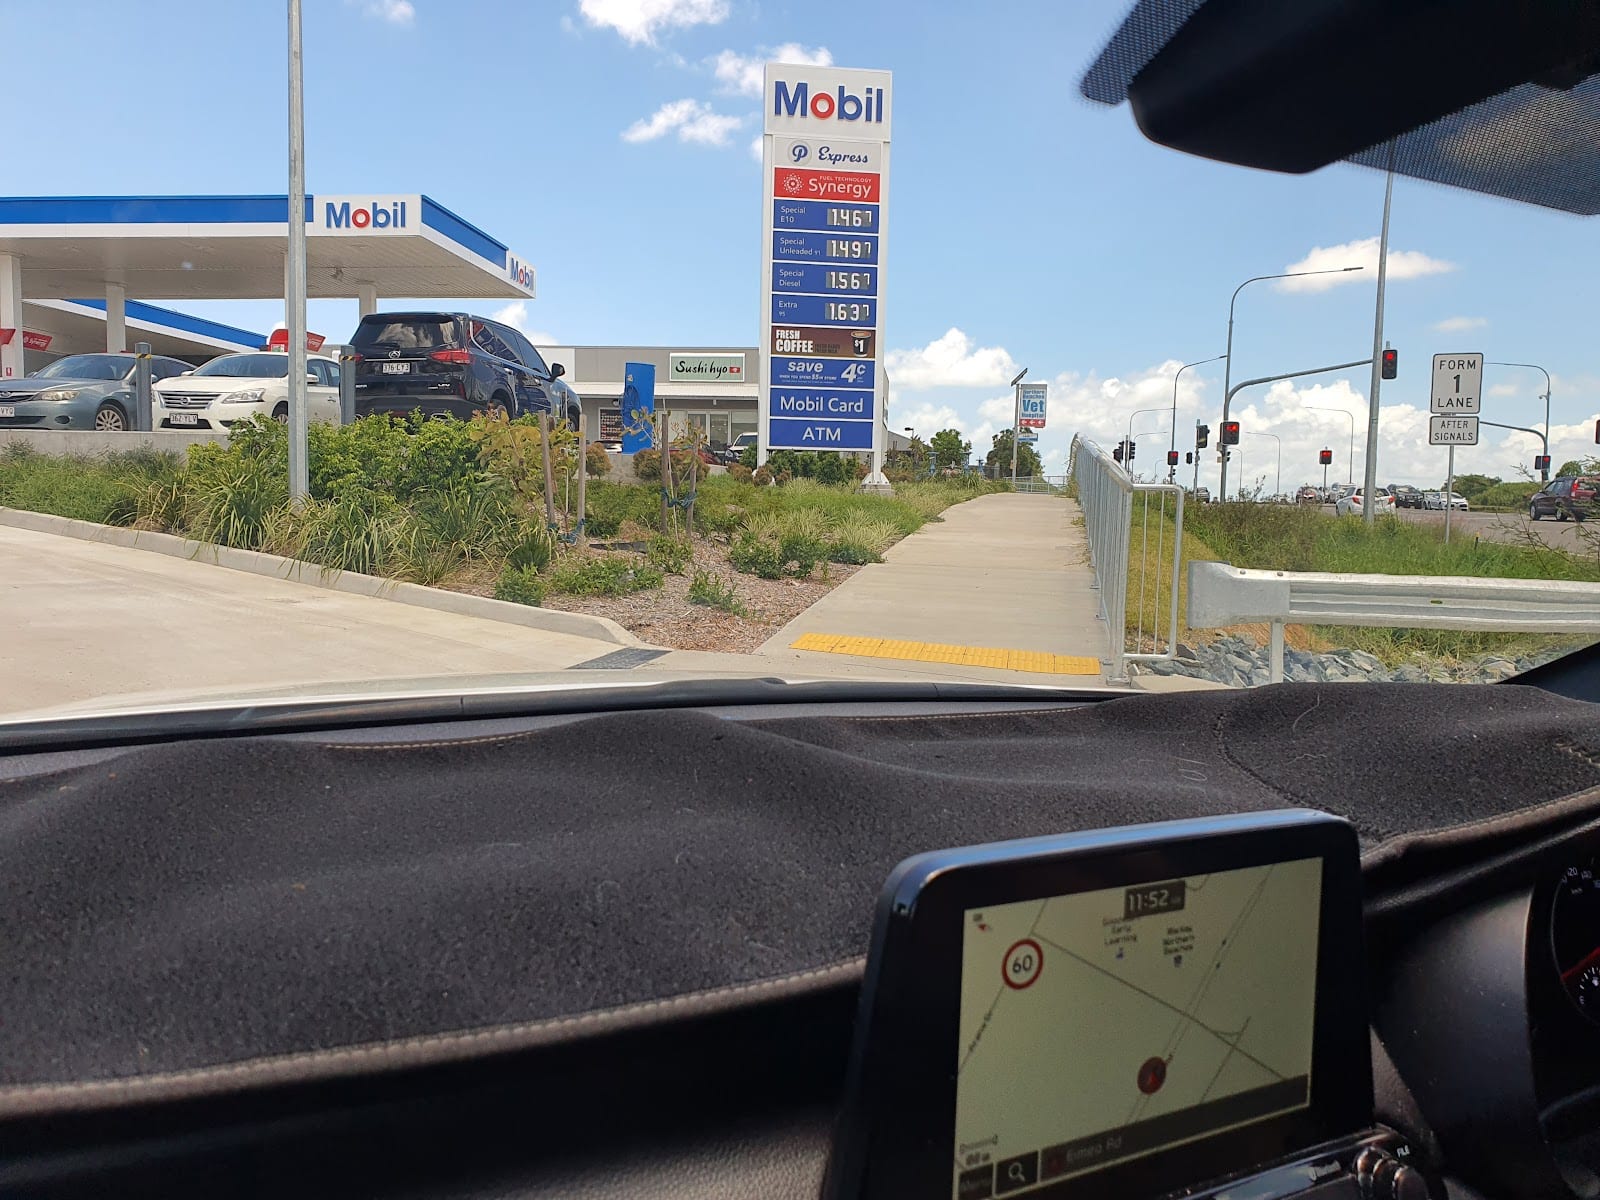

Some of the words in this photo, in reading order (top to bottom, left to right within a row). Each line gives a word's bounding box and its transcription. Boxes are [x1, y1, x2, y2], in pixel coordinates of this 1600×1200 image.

[774, 80, 884, 123] Mobil
[818, 146, 869, 165] Express
[835, 176, 872, 184] TECHNOLOGY
[808, 178, 872, 199] Synergy
[326, 202, 406, 229] Mobil
[780, 205, 806, 215] Special
[780, 237, 805, 246] Special
[510, 257, 535, 291] Mobil
[779, 269, 805, 278] Special
[778, 301, 798, 309] Extra
[776, 330, 800, 340] FRESH
[775, 340, 814, 353] COFFEE
[854, 339, 864, 353] $1
[788, 361, 824, 373] save
[1439, 360, 1477, 370] FORM
[1453, 374, 1461, 394] 1
[780, 396, 824, 412] Mobil
[828, 398, 864, 413] Card
[1022, 399, 1045, 413] Vet
[1438, 397, 1473, 408] LANE
[1440, 420, 1469, 428] AFTER
[802, 427, 841, 441] ATM
[1434, 432, 1474, 441] SIGNALS
[1128, 889, 1169, 912] 11:52
[1012, 954, 1033, 974] 60
